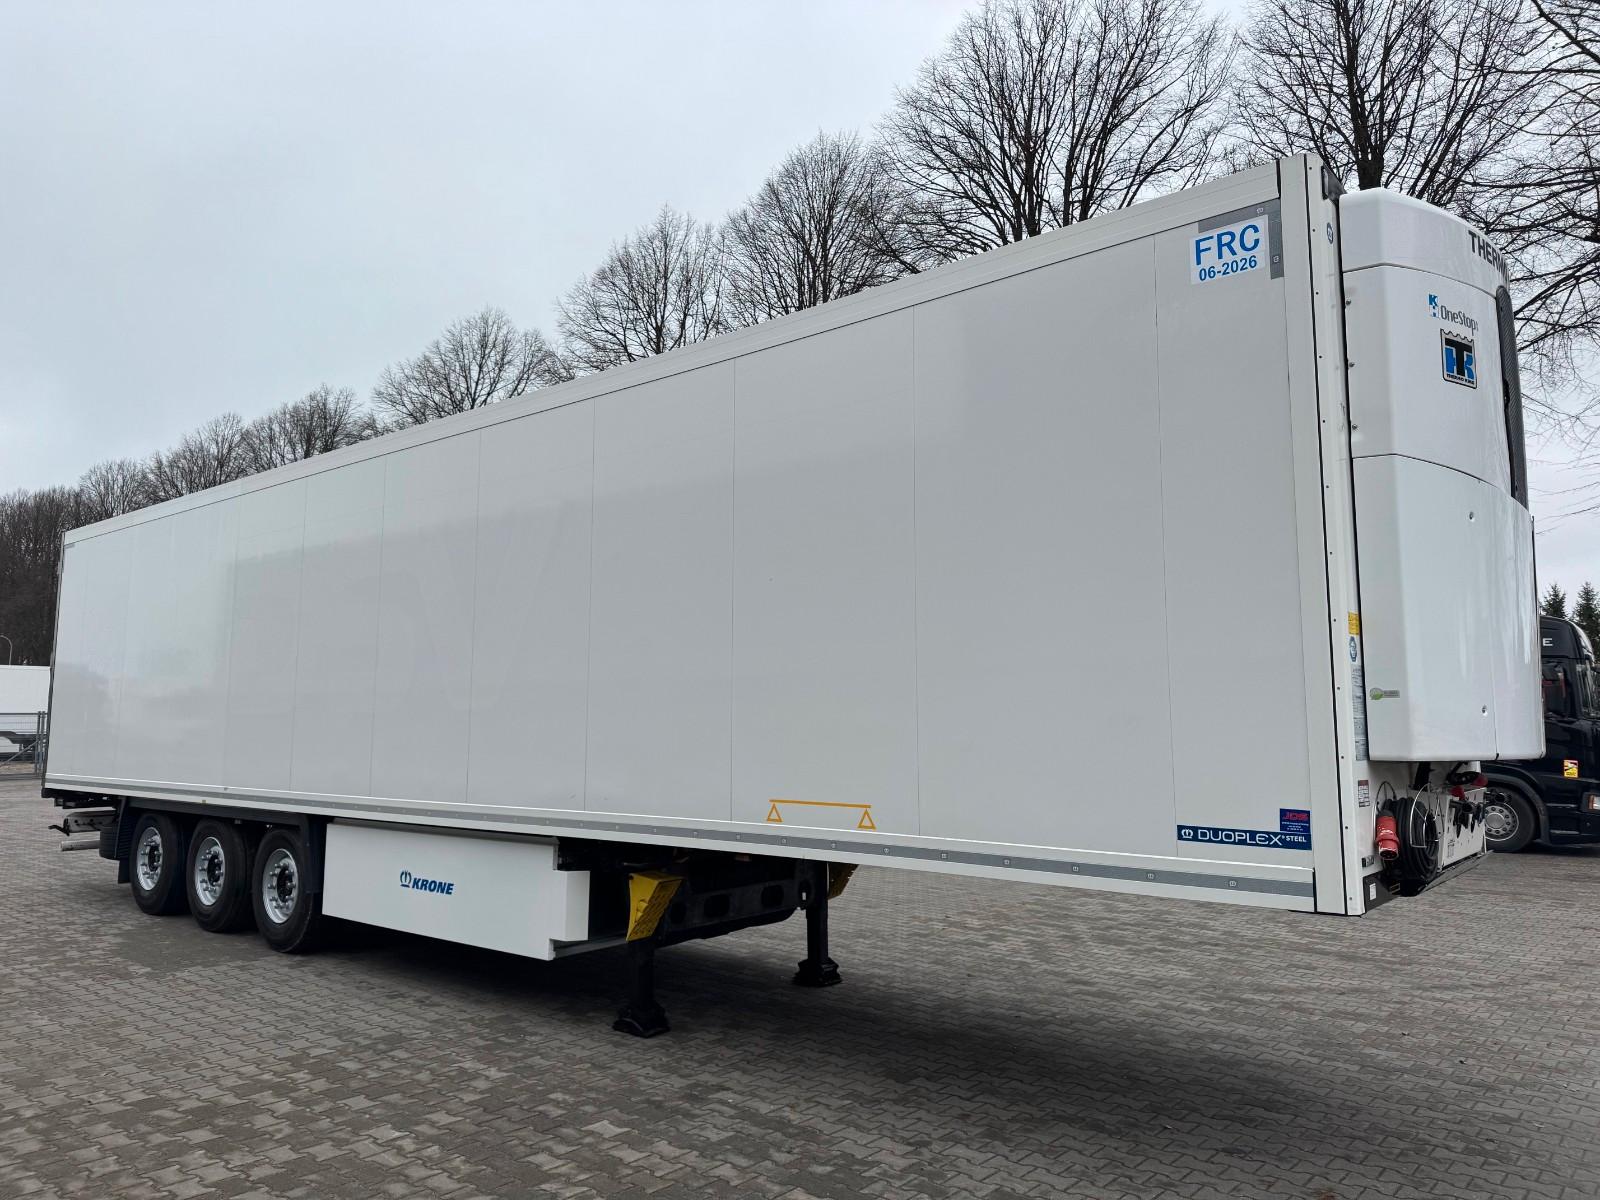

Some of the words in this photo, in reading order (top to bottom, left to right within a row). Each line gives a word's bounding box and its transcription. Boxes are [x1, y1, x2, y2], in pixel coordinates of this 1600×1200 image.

[1195, 224, 1260, 266] FRC
[1199, 255, 1258, 281] 06-2026
[1198, 829, 1282, 846] DUOPLEX
[1286, 835, 1307, 843] STEEL
[412, 877, 454, 895] KRONE
